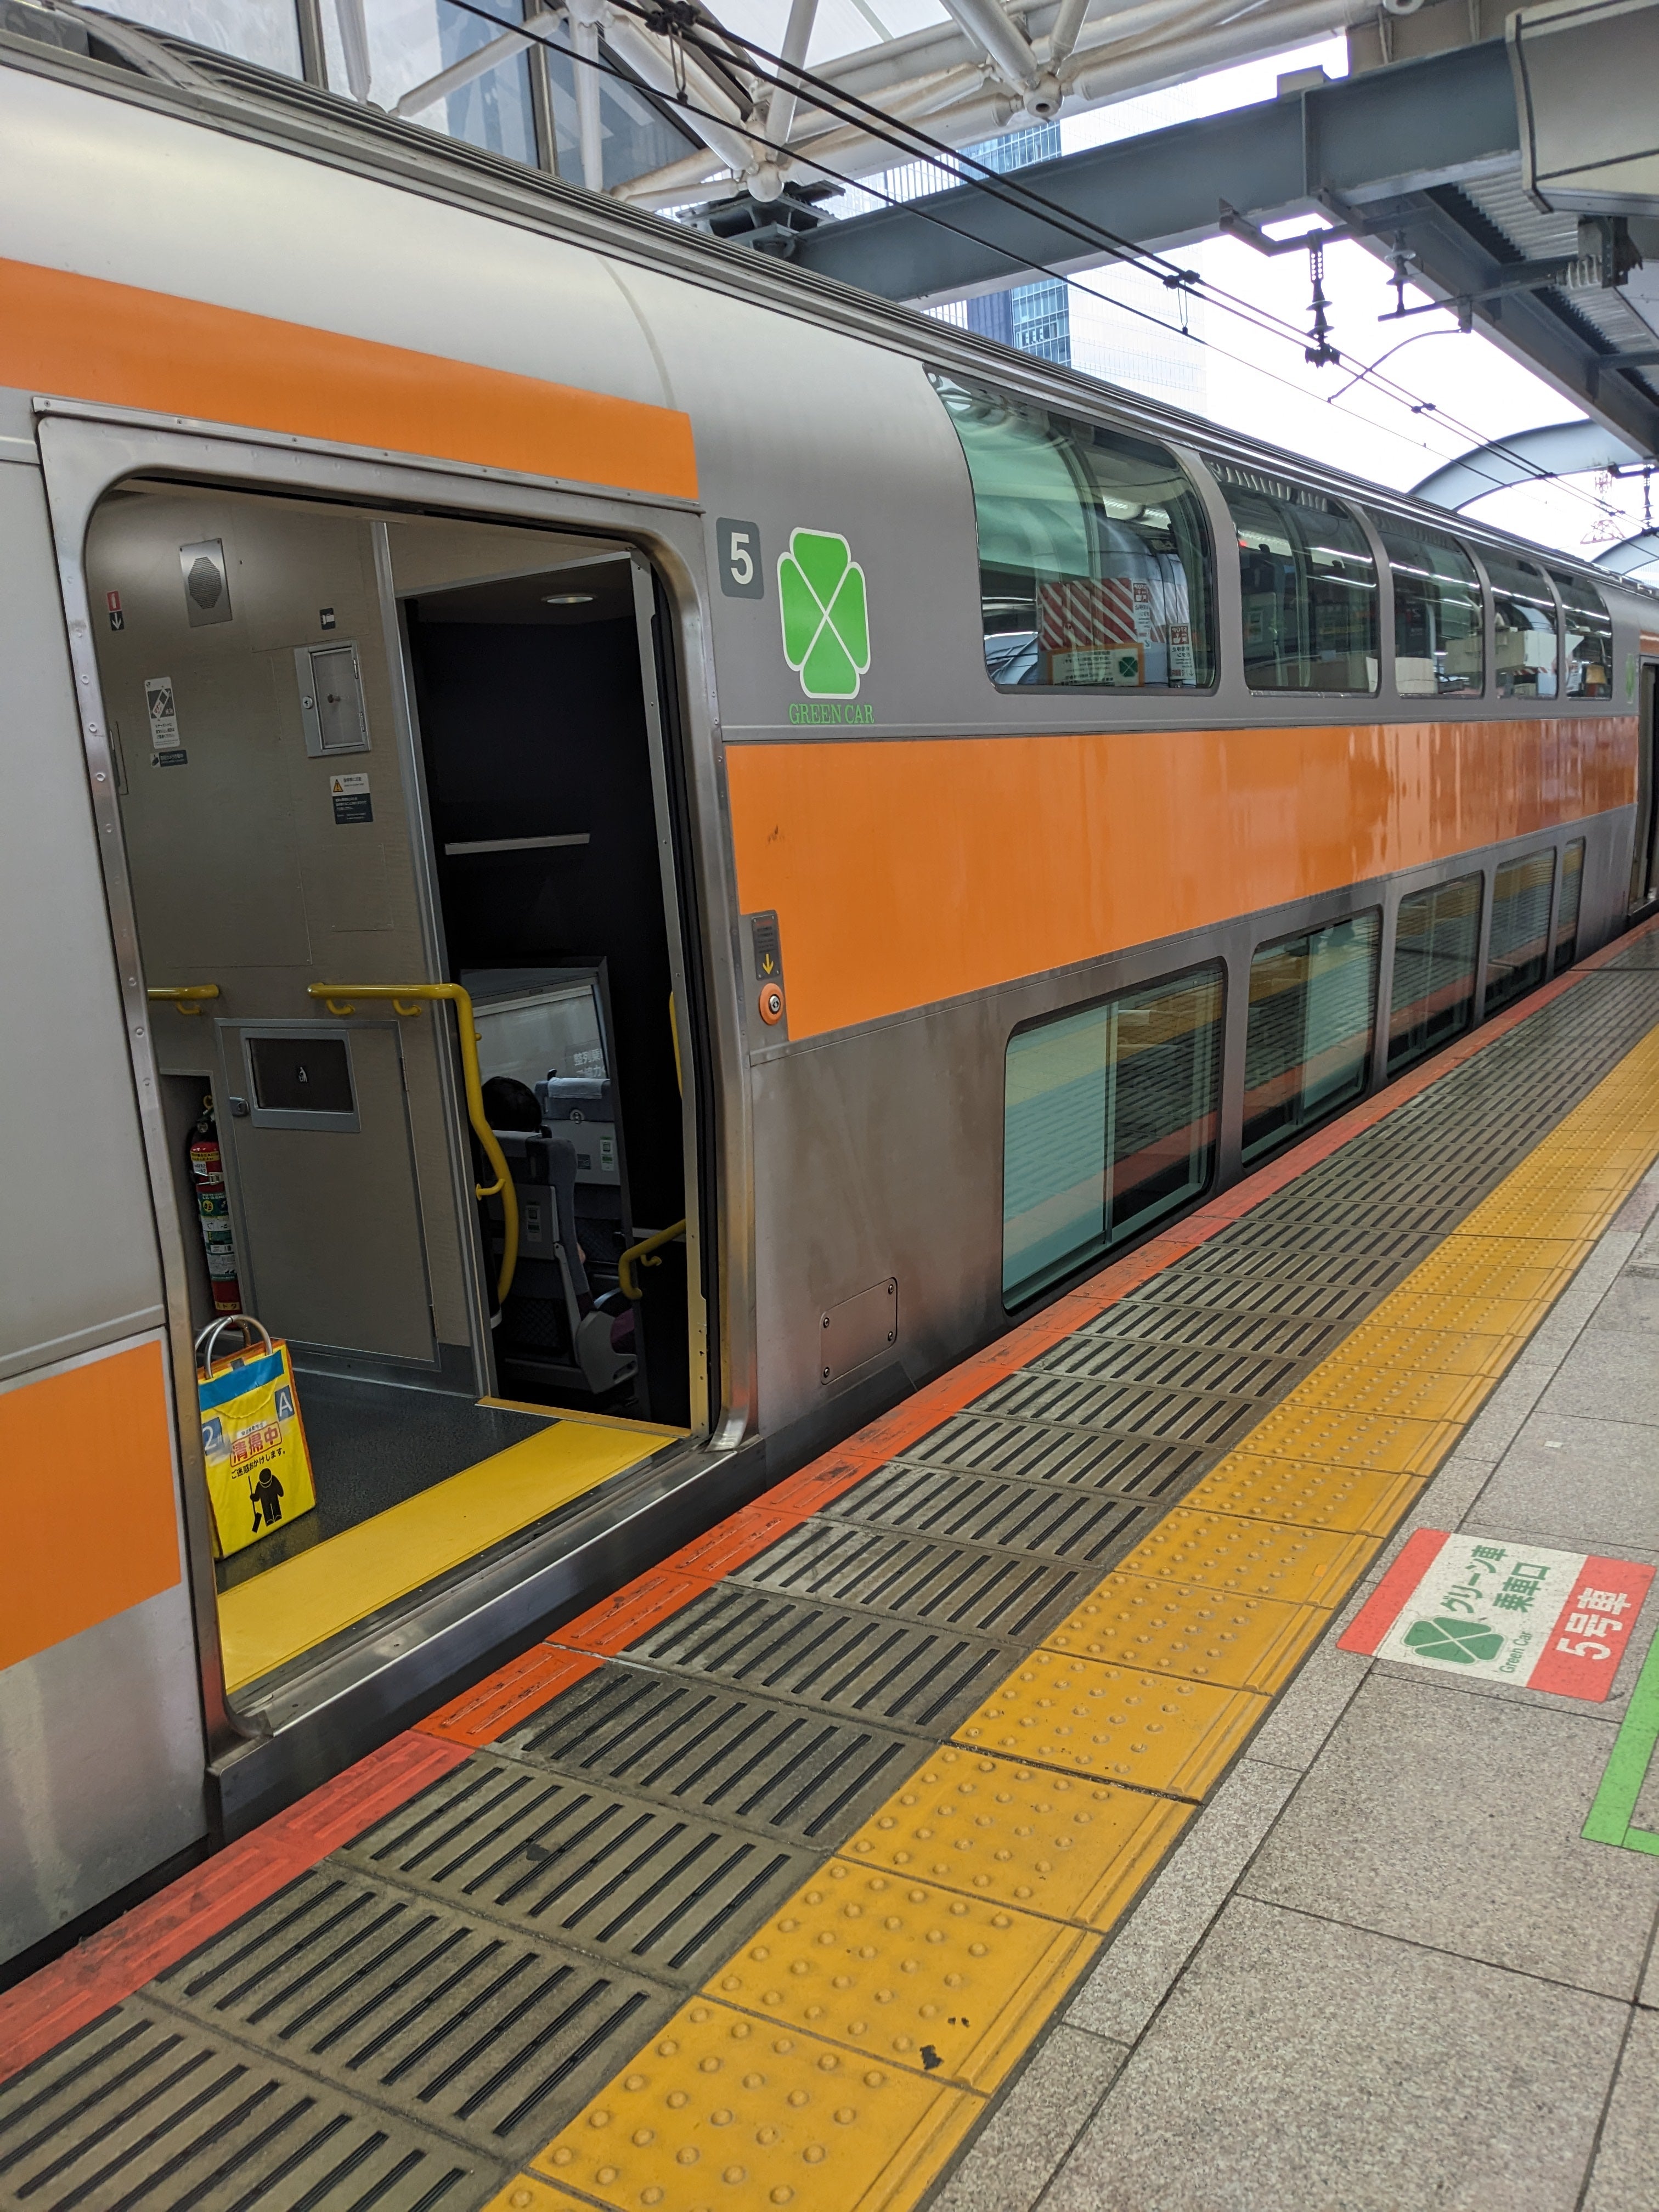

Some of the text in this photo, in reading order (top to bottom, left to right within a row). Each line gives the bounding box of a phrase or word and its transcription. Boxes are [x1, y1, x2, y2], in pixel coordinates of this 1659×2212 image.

[731, 532, 754, 585] 5
[789, 703, 875, 725] GREEN CAR
[573, 1048, 603, 1066] 整列乗
[279, 1391, 294, 1418] A
[202, 1425, 217, 1453] 2
[231, 1427, 279, 1465] 清掃中
[232, 1447, 286, 1479] ご迷惑おかけします。
[1440, 1545, 1508, 1613] グリーン車
[1492, 1561, 1551, 1613] 乗車口
[1555, 1587, 1632, 1661] 5号車
[1499, 1631, 1533, 1673] Green Car
